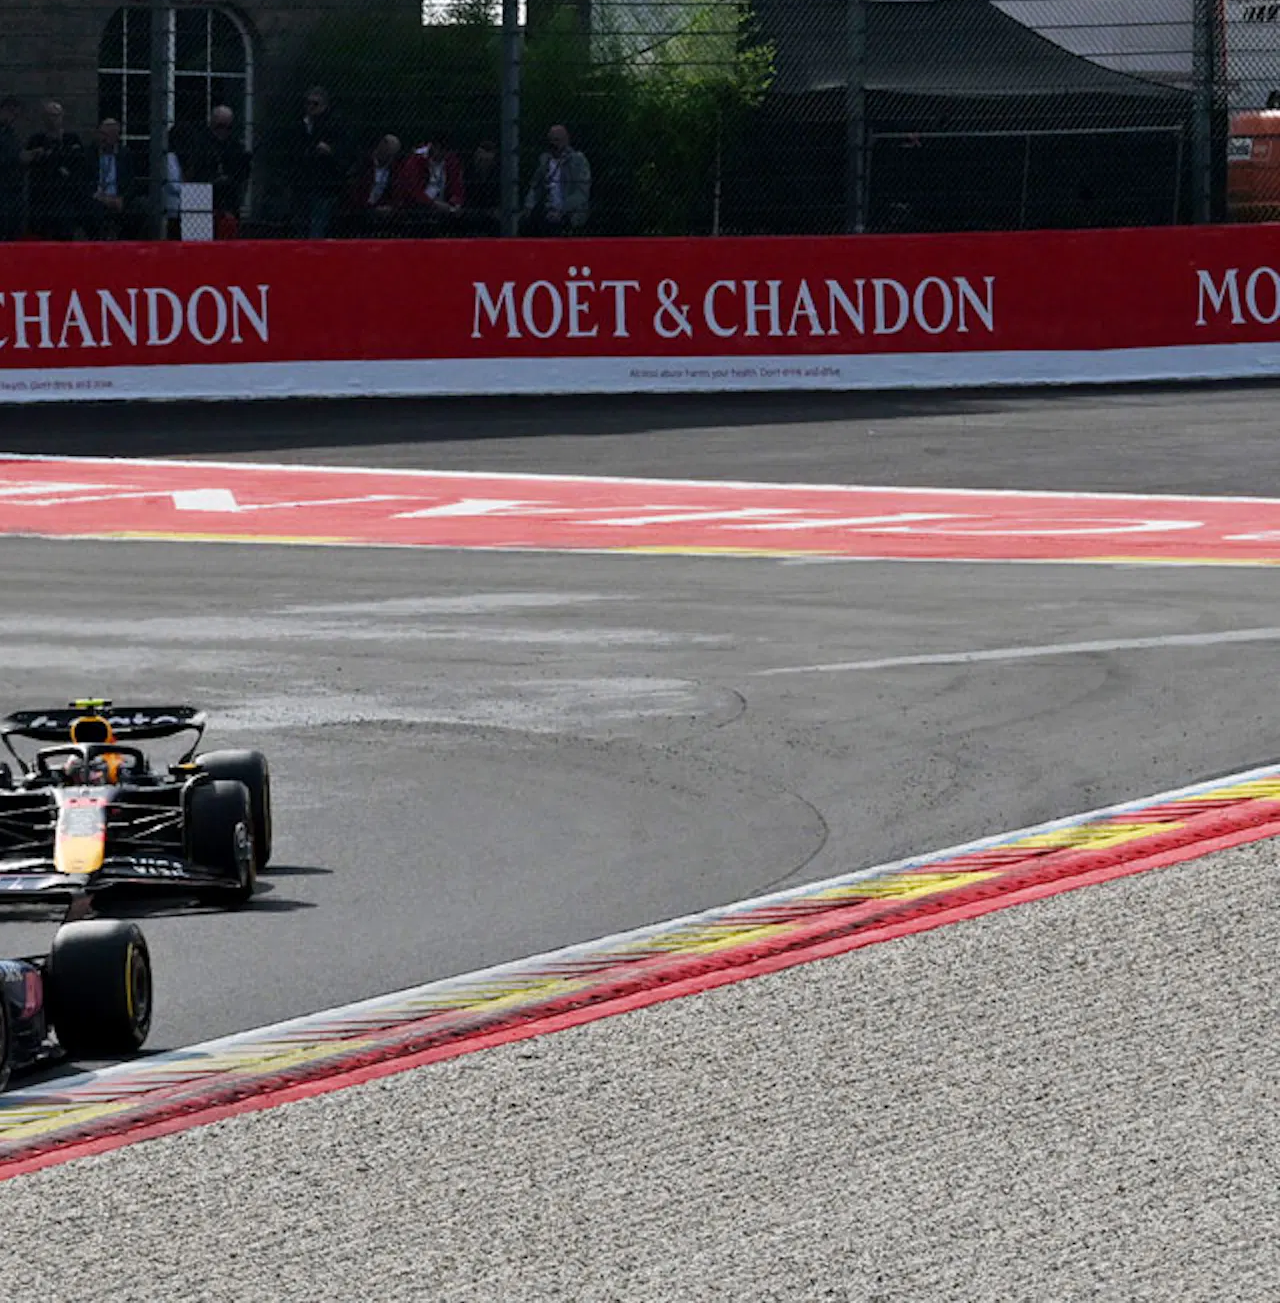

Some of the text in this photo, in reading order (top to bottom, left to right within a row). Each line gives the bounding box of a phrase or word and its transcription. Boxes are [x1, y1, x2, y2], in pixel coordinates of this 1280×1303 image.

[471, 266, 995, 338] MOËT & CHANDON
